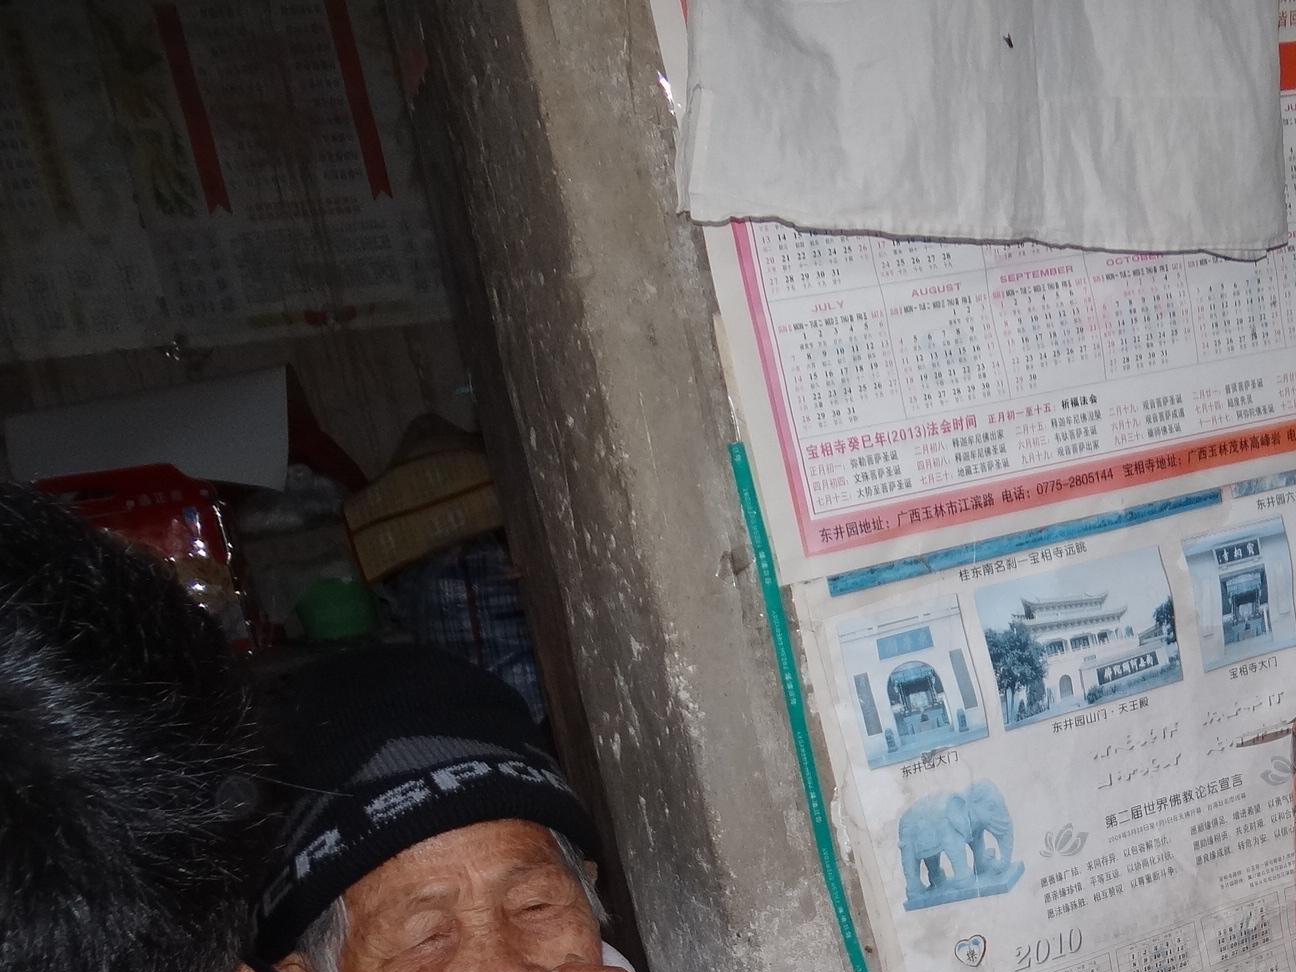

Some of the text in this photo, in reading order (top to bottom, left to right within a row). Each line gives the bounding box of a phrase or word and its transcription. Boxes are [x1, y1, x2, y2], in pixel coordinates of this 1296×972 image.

[1000, 265, 1073, 284] SEPTEMBER
[911, 282, 962, 298] AUGUST
[812, 300, 843, 312] JULY
[1229, 656, 1278, 681] 宝相寺大门
[1105, 773, 1243, 829] 第二届世界佛教论坛宣言
[1015, 927, 1082, 972] 2010
